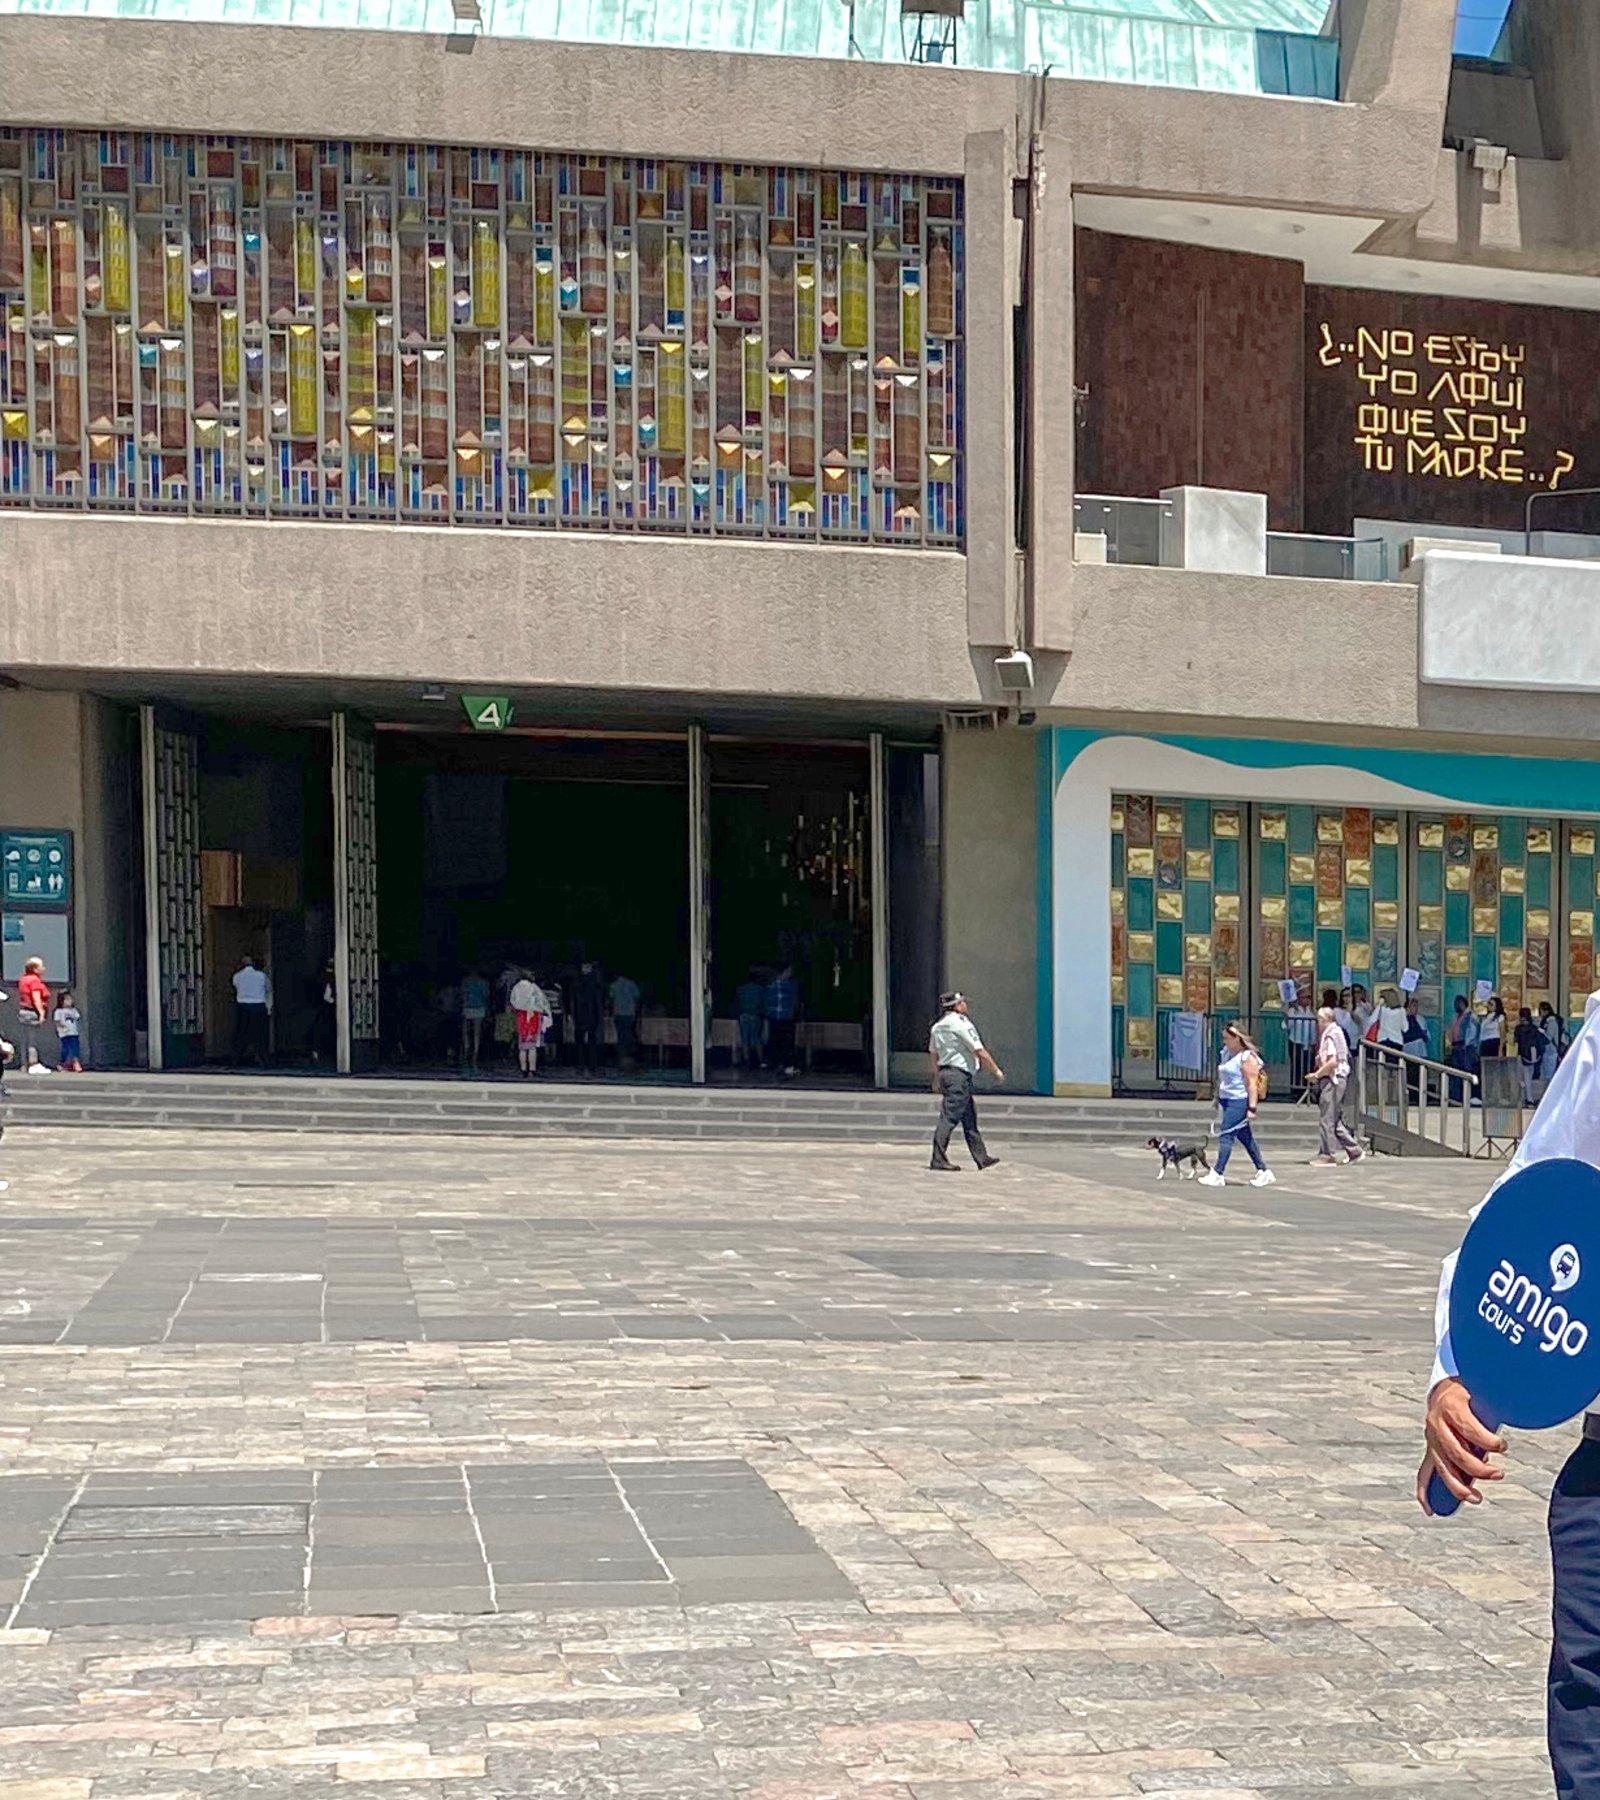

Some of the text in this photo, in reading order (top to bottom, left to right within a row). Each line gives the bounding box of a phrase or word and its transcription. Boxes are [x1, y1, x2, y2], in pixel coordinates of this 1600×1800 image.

[1358, 362, 1418, 397] YO
[1358, 402, 1527, 444] QUE SOY
[1354, 434, 1394, 472] TU
[477, 702, 501, 728] 4
[1478, 1292, 1526, 1345] tours
[1489, 1259, 1588, 1356] amigo
